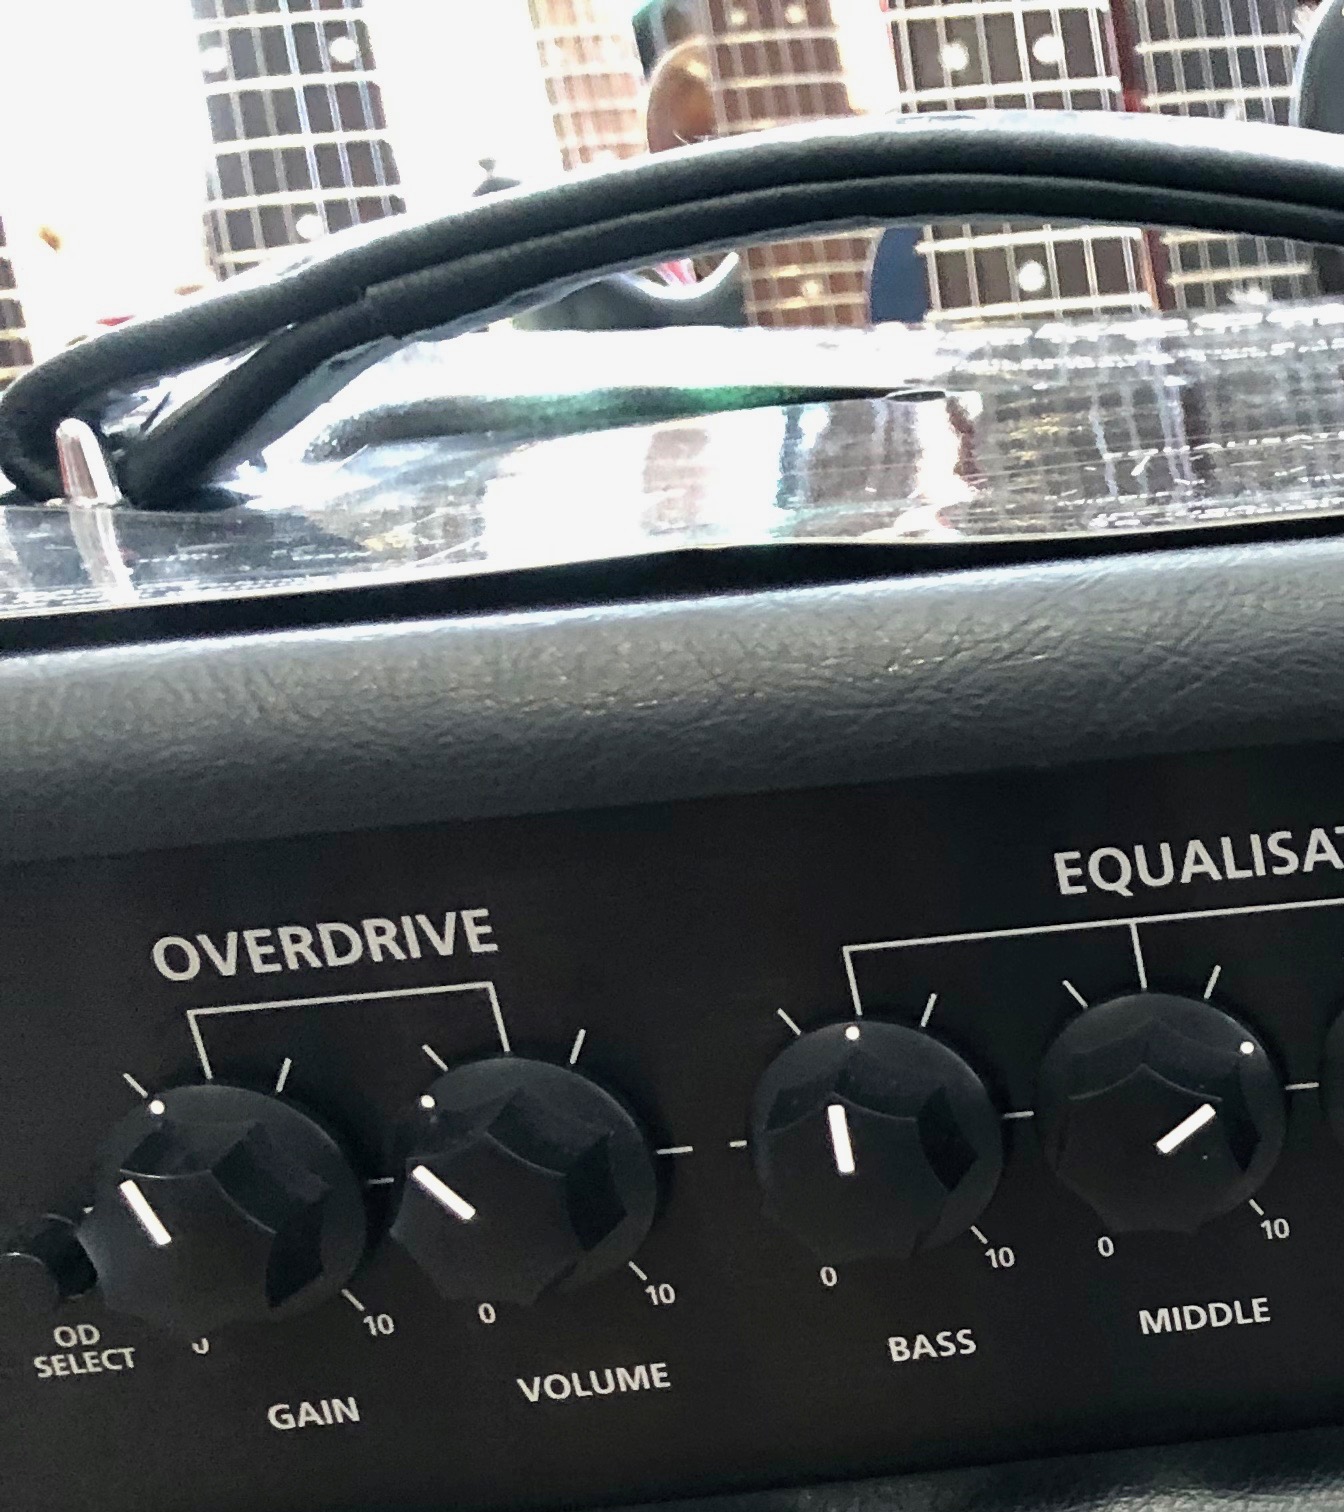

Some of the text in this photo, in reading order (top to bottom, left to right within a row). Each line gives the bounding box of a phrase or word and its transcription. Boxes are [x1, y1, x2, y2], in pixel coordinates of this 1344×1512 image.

[152, 908, 499, 982] OVERDRIVE
[1261, 1218, 1290, 1240] 10
[985, 1246, 1015, 1269] 10
[1097, 1236, 1115, 1258] 0
[819, 1266, 838, 1287] 0
[644, 1283, 676, 1306] 10
[478, 1302, 496, 1324] 0
[1138, 1297, 1271, 1335] MIDDLE
[53, 1324, 101, 1348] OD
[364, 1314, 395, 1336] 10
[887, 1328, 977, 1362] BASS
[33, 1347, 136, 1378] SELECT
[516, 1362, 671, 1403] VOLUME
[267, 1396, 360, 1430] GAIN
